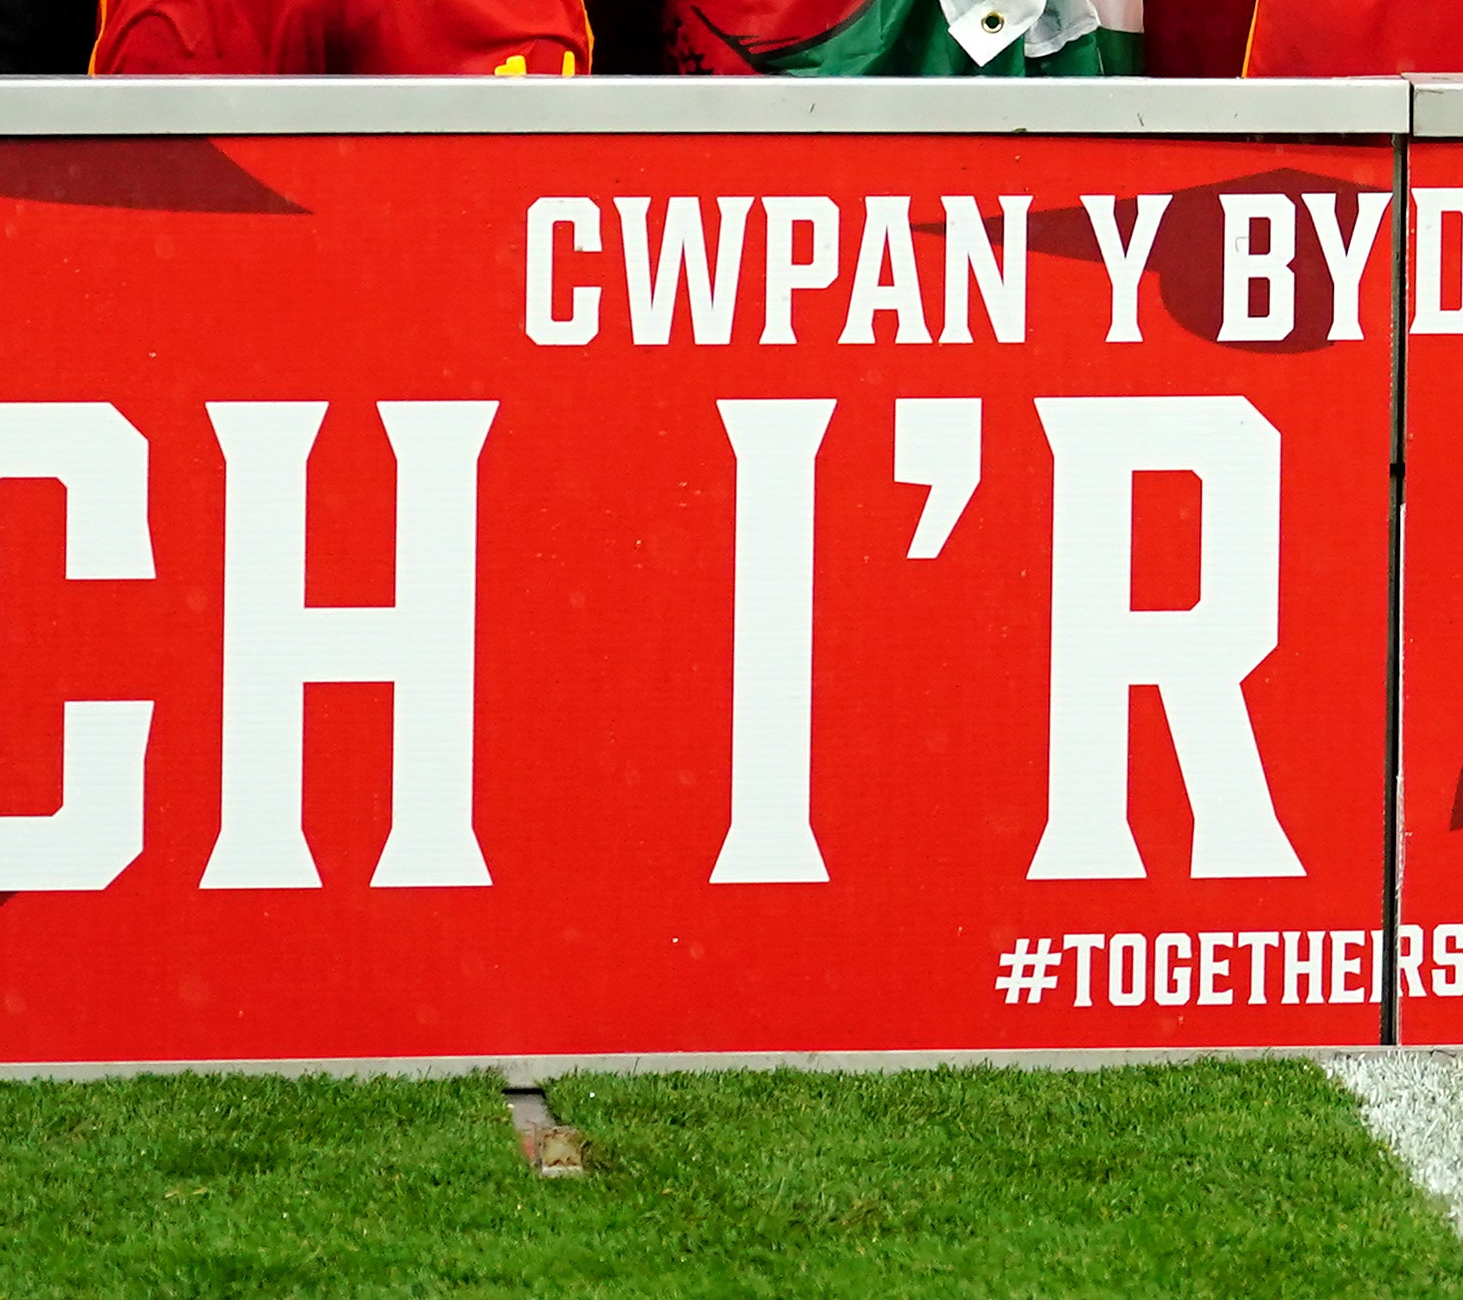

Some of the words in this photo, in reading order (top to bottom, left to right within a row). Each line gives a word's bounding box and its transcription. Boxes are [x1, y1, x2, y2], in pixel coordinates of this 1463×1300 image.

[525, 195, 1027, 346] CWPAN
[1080, 194, 1174, 343] Y
[709, 395, 1309, 885] I'R
